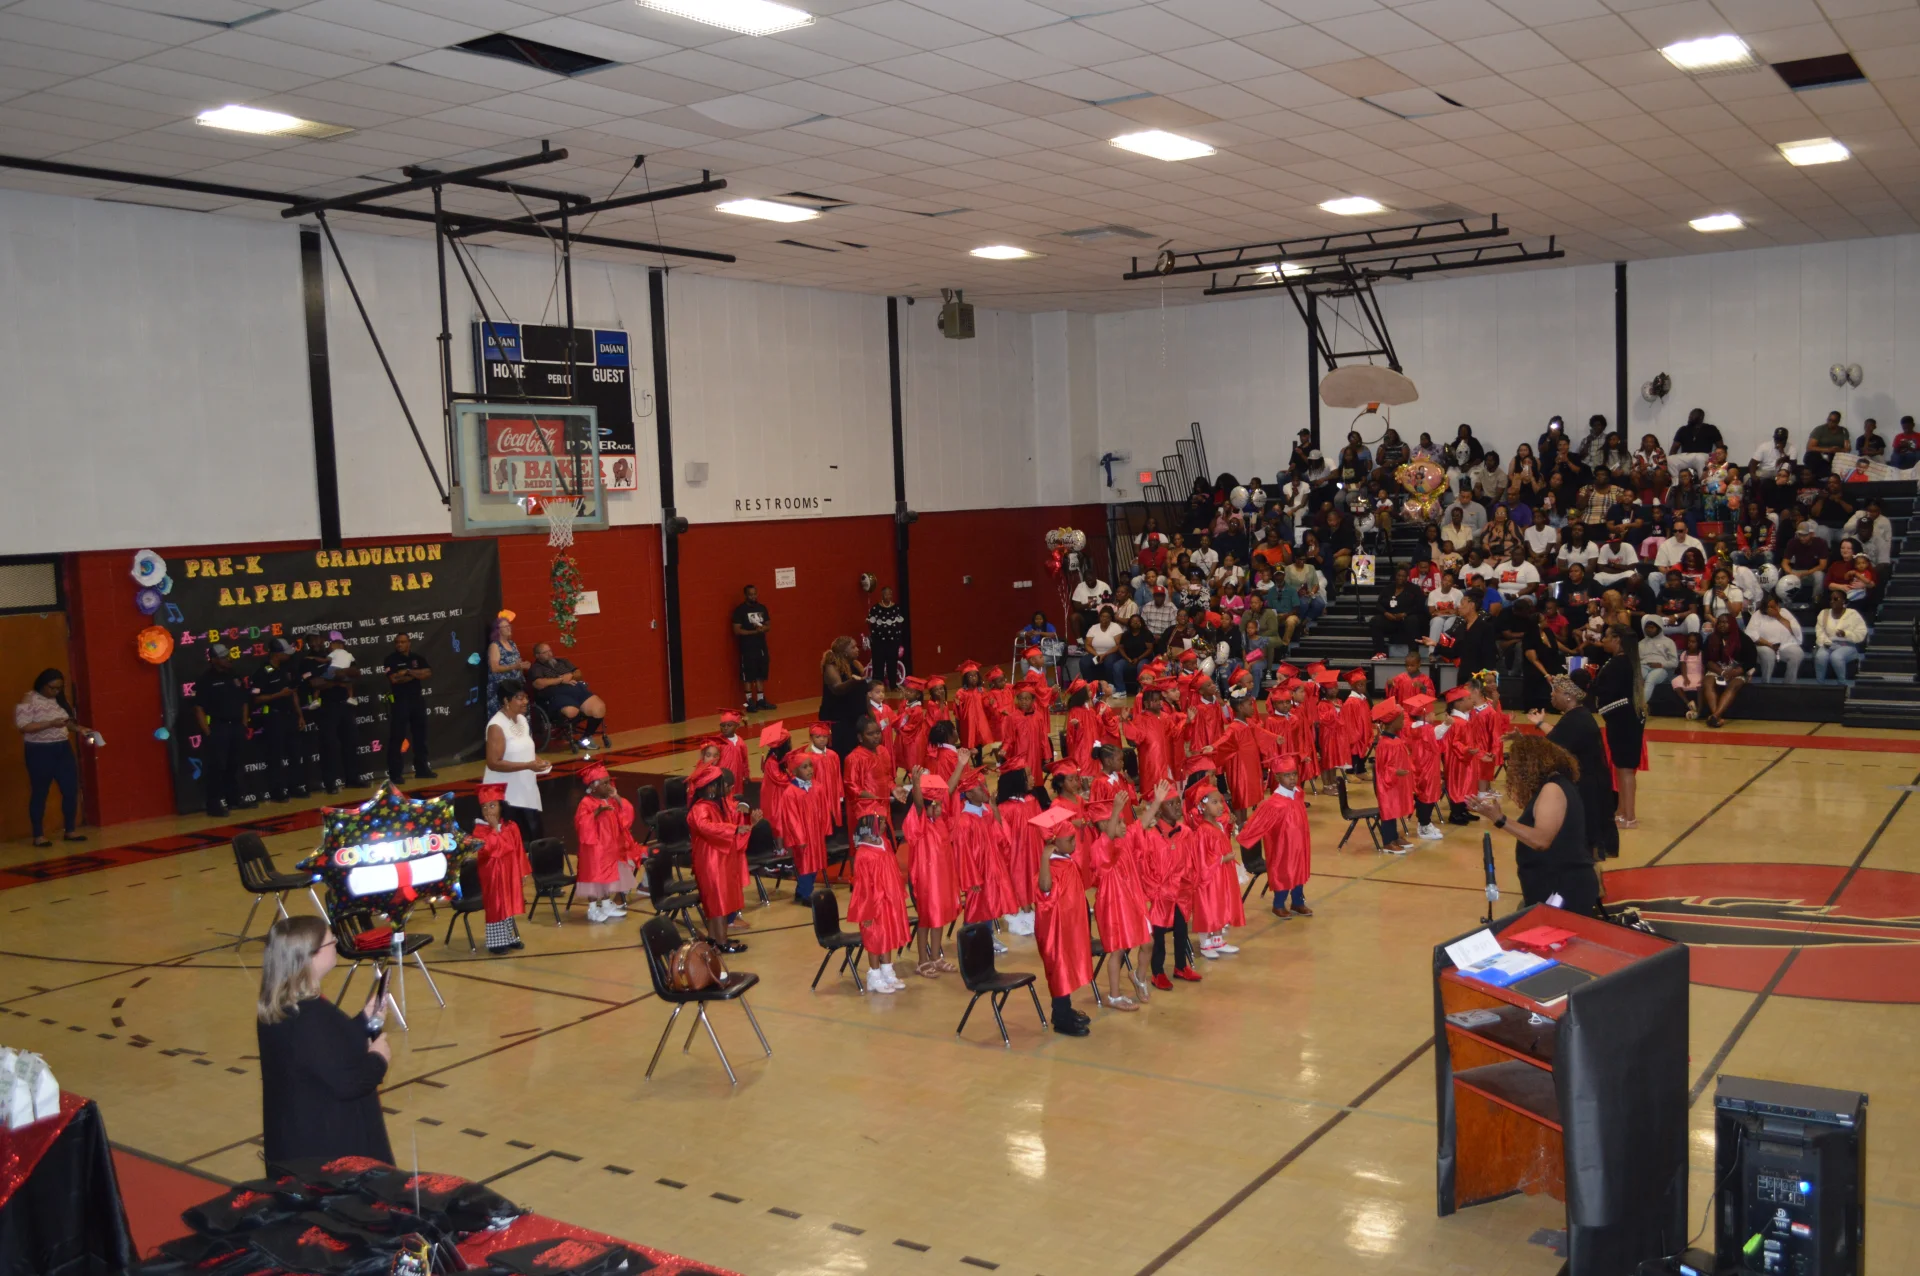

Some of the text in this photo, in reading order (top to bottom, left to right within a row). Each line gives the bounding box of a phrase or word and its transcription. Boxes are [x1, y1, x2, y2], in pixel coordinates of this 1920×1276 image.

[600, 343, 625, 354] DASANI
[592, 368, 625, 383] GUEST
[497, 427, 558, 453] Coca-Cola
[524, 459, 607, 479] BAKER
[735, 497, 819, 511] RESTROOMS
[185, 544, 442, 578] PRE-K GRADUATION
[219, 572, 434, 606] ALPHABET RAP
[359, 618, 376, 627] WILL
[380, 616, 389, 626] BE
[391, 614, 405, 624] THE
[408, 612, 431, 622] PLACE
[432, 610, 447, 620] FOR
[360, 635, 379, 645] BEST
